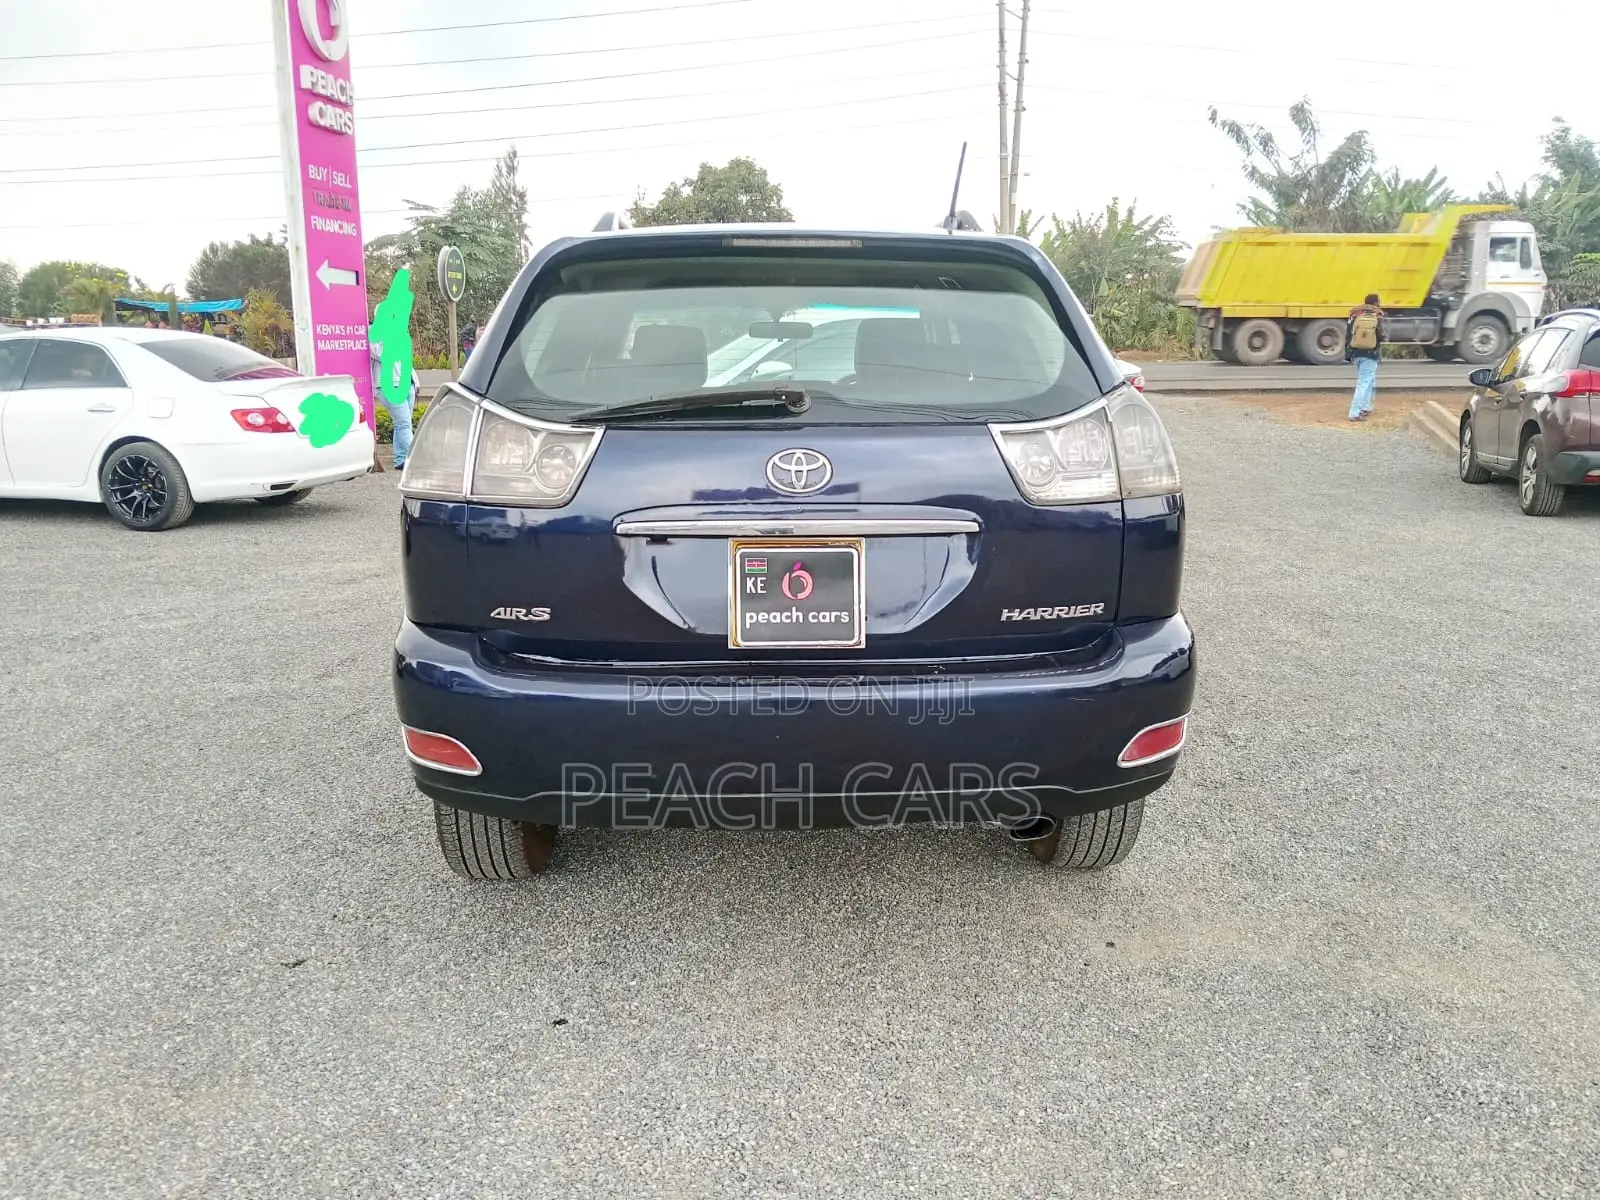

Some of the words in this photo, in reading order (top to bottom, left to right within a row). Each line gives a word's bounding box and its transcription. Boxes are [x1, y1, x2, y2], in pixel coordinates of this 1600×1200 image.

[299, 64, 354, 106] PEACH
[308, 101, 353, 135] CARS
[308, 164, 328, 182] BUY
[332, 170, 352, 189] SELL
[310, 215, 357, 236] FINANCING
[316, 323, 346, 336] KENYA'S
[354, 325, 366, 336] CAR
[317, 339, 368, 351] MARKETPLACE
[746, 577, 767, 594] KE
[745, 606, 804, 629] peach
[808, 611, 850, 623] cars
[1000, 602, 1105, 622] HARRIER
